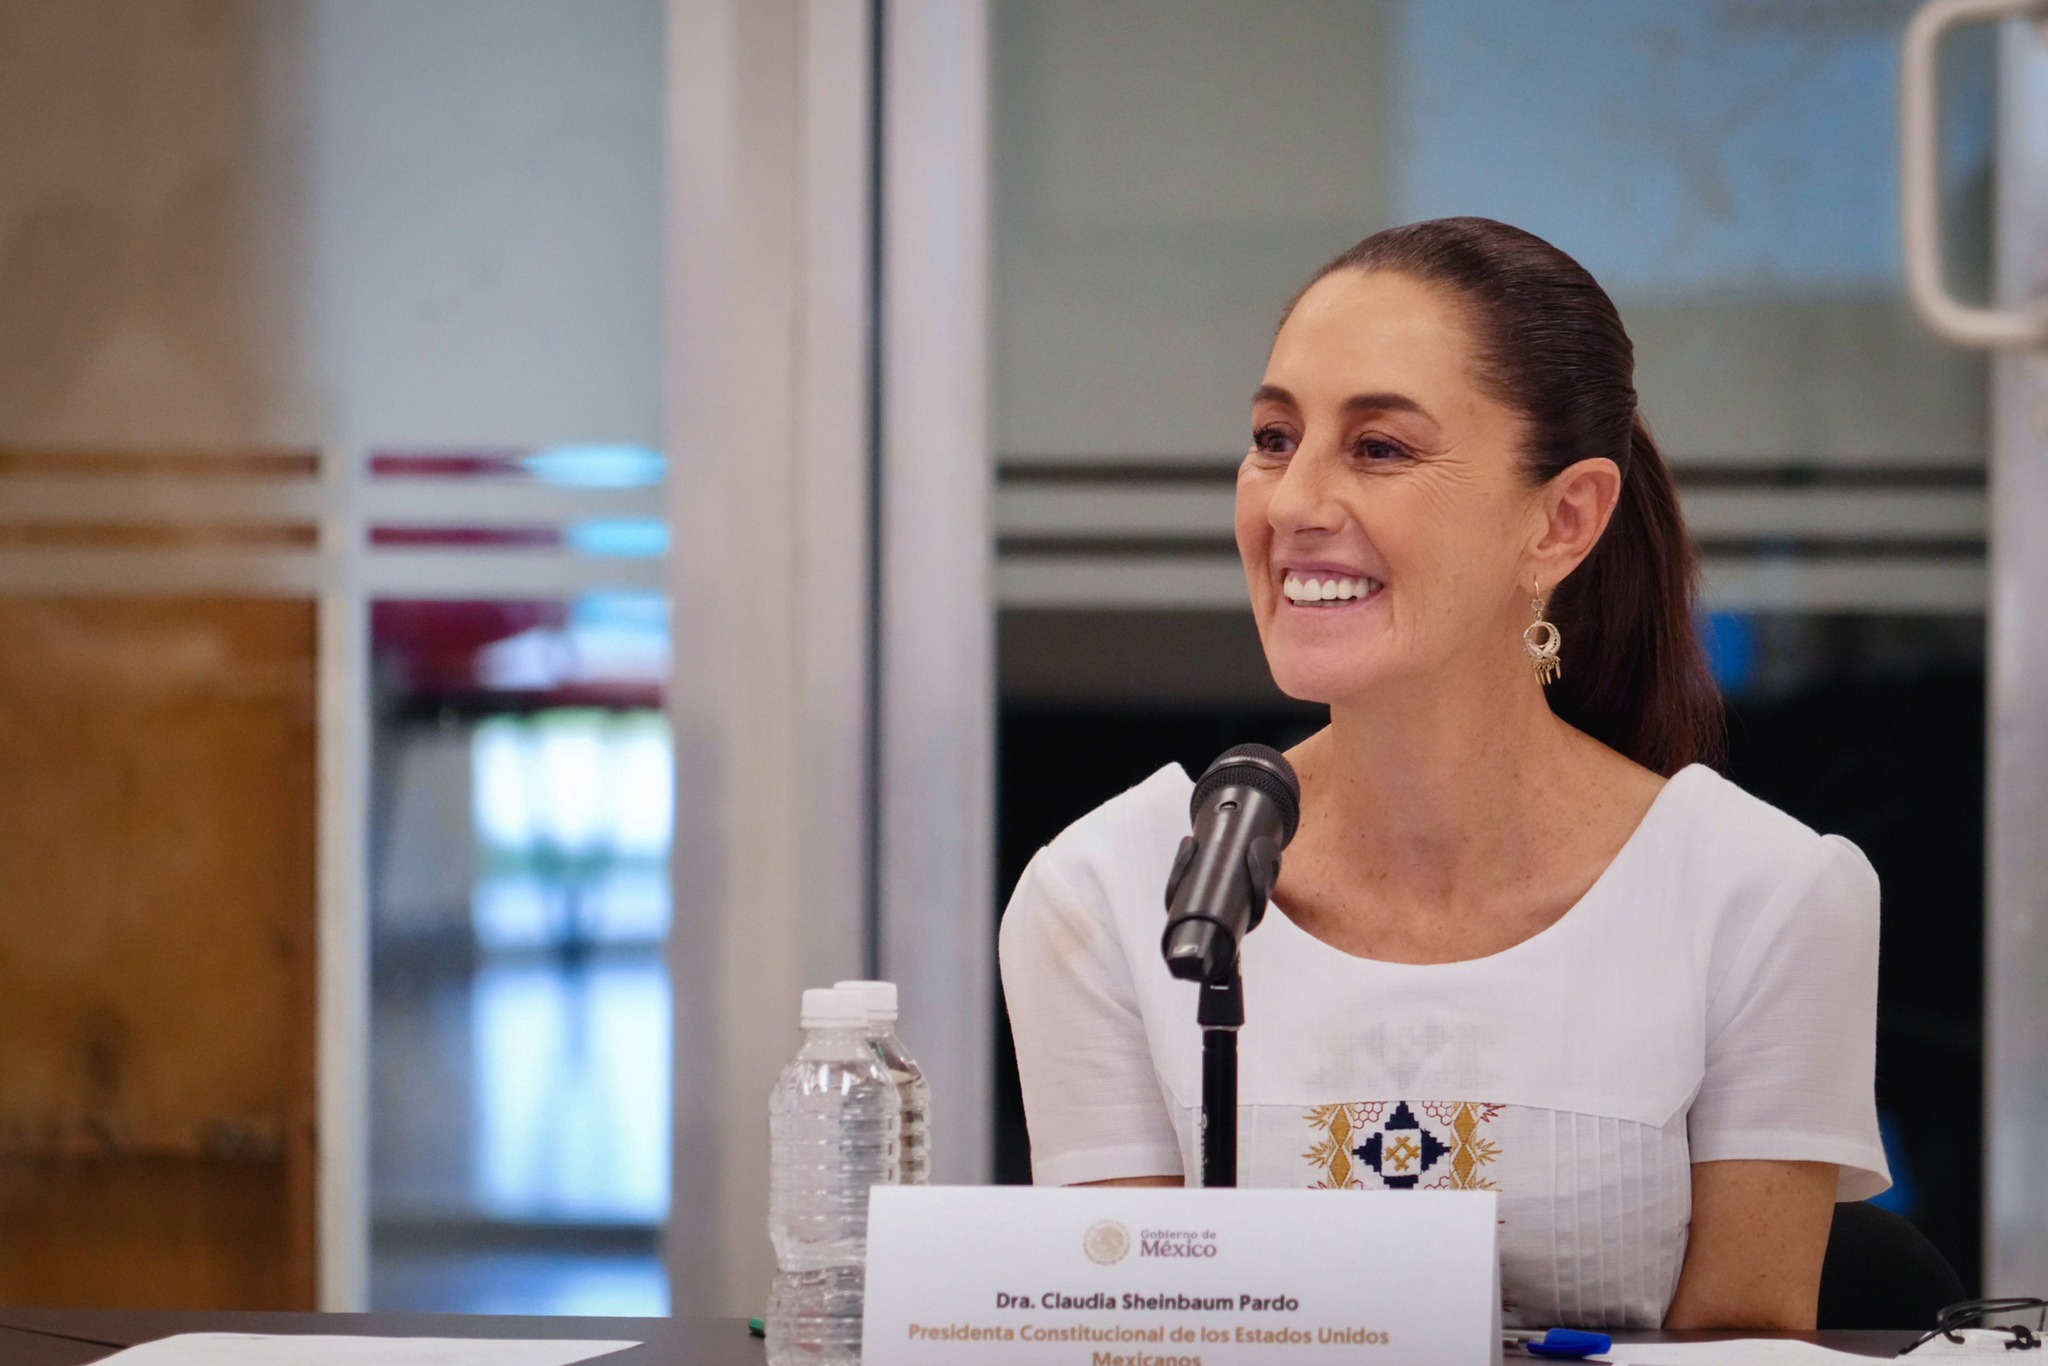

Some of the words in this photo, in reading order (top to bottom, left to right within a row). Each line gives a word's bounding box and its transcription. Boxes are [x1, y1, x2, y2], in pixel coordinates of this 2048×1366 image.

[1140, 1230, 1198, 1240] Gobierno
[1202, 1230, 1217, 1240] de
[1140, 1239, 1217, 1258] México
[996, 1292, 1036, 1309] Dra.
[1041, 1292, 1117, 1310] Claudia
[1122, 1293, 1234, 1311] Sheinbaum
[1239, 1294, 1299, 1312] Pardo
[908, 1324, 1015, 1342] Presidenta
[1020, 1325, 1165, 1343] Constitucional
[1170, 1326, 1196, 1343] de
[1201, 1326, 1230, 1343] los
[1235, 1327, 1313, 1344] Estados
[1318, 1327, 1390, 1345] Unidos
[1092, 1351, 1203, 1366] Mexicanos
